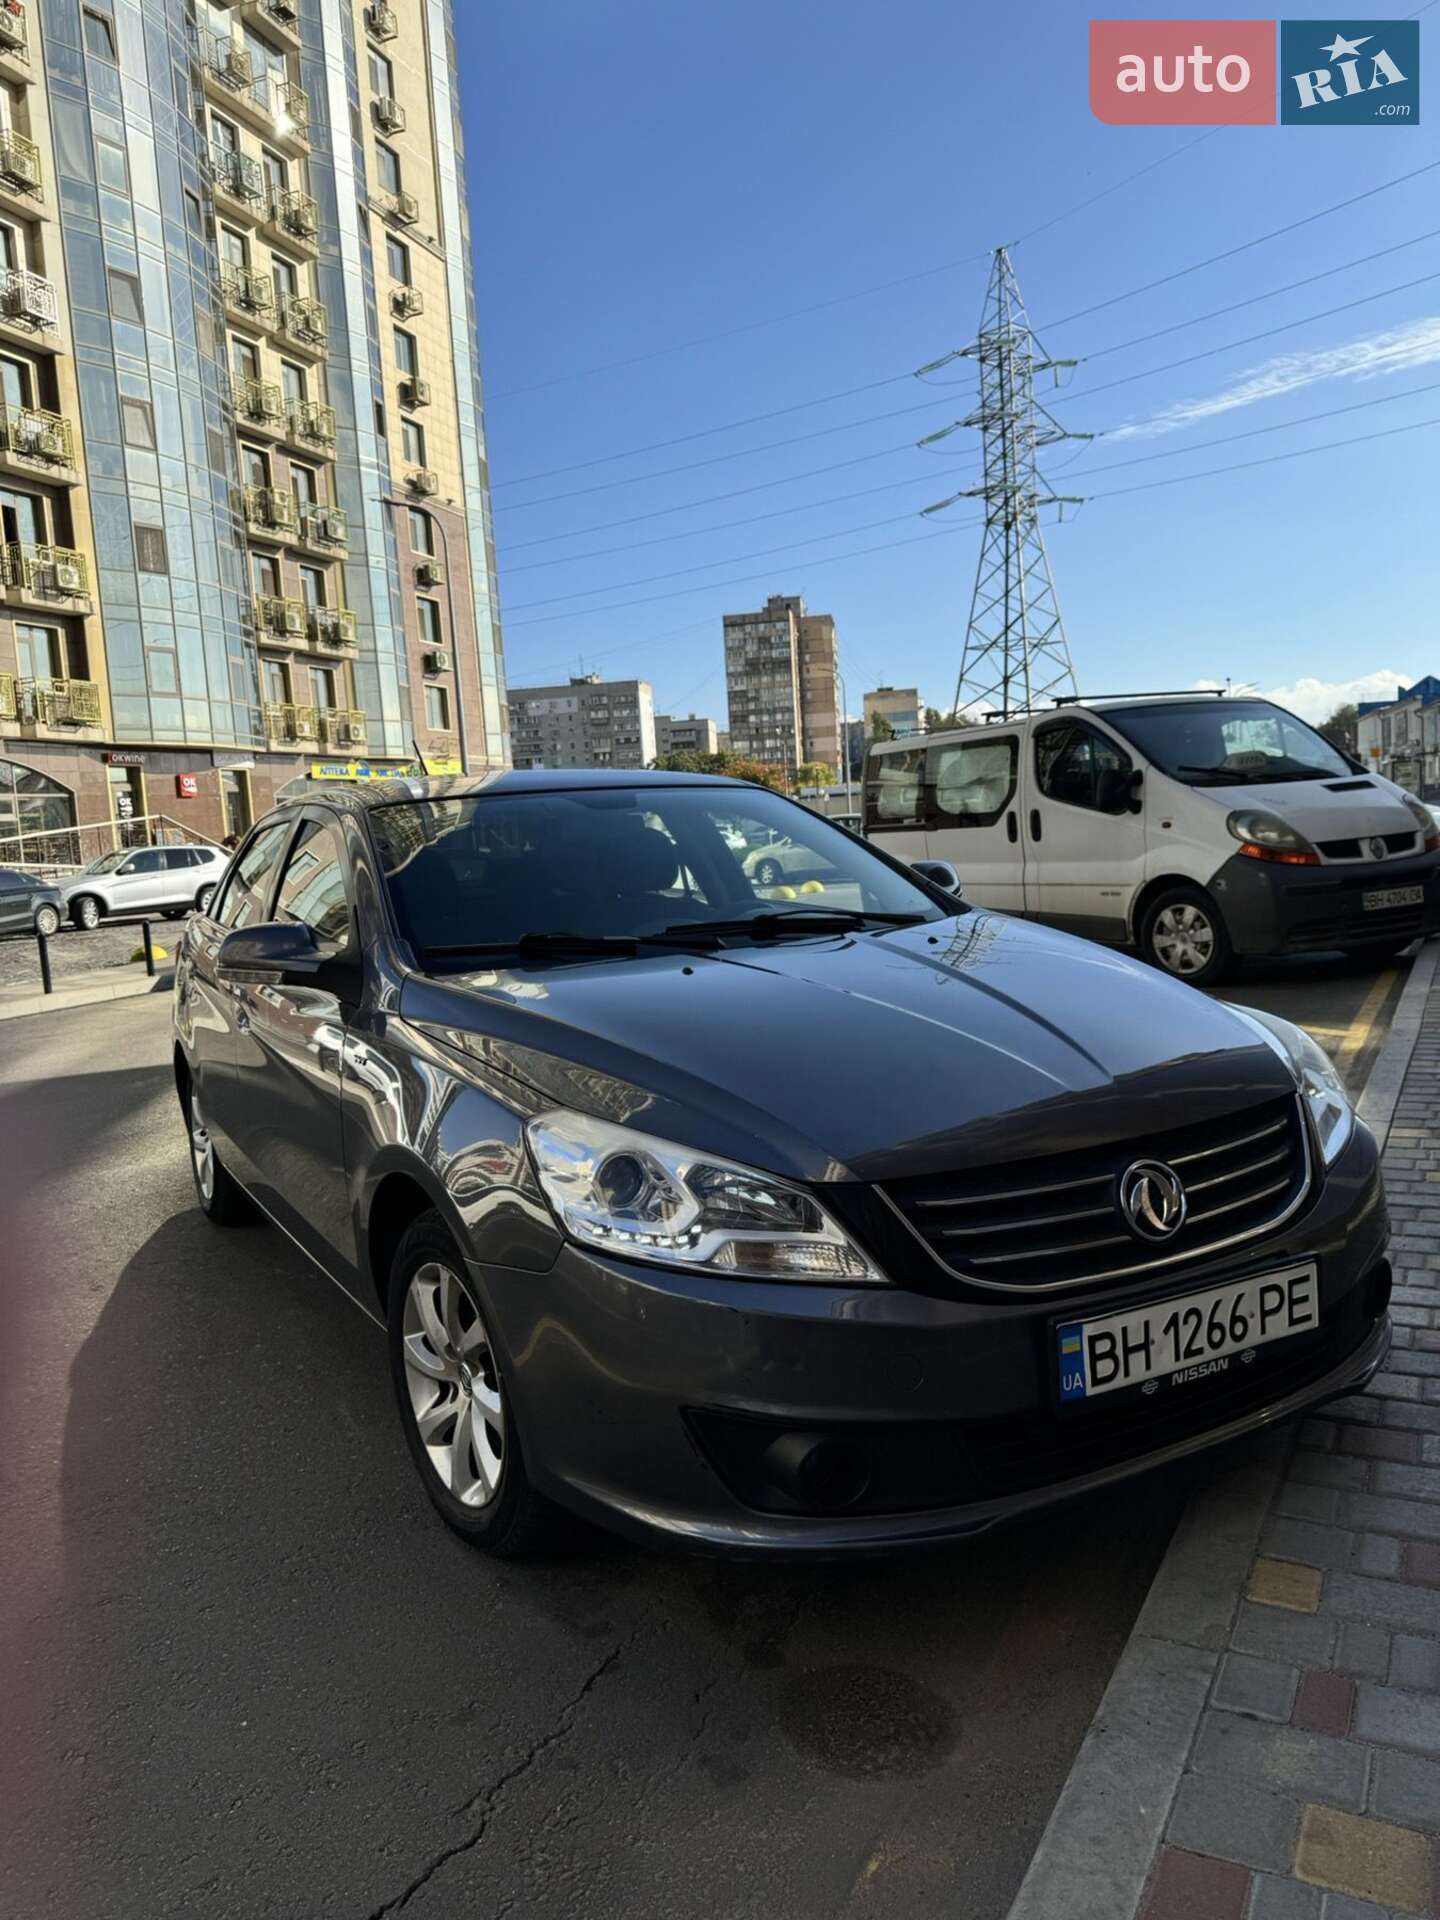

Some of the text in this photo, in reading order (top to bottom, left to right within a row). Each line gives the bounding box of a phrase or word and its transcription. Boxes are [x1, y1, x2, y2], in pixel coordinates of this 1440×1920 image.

[1087, 1273, 1314, 1388] BH 1266 PE
[1062, 1372, 1084, 1392] UA
[1171, 1357, 1230, 1387] NISSAN
